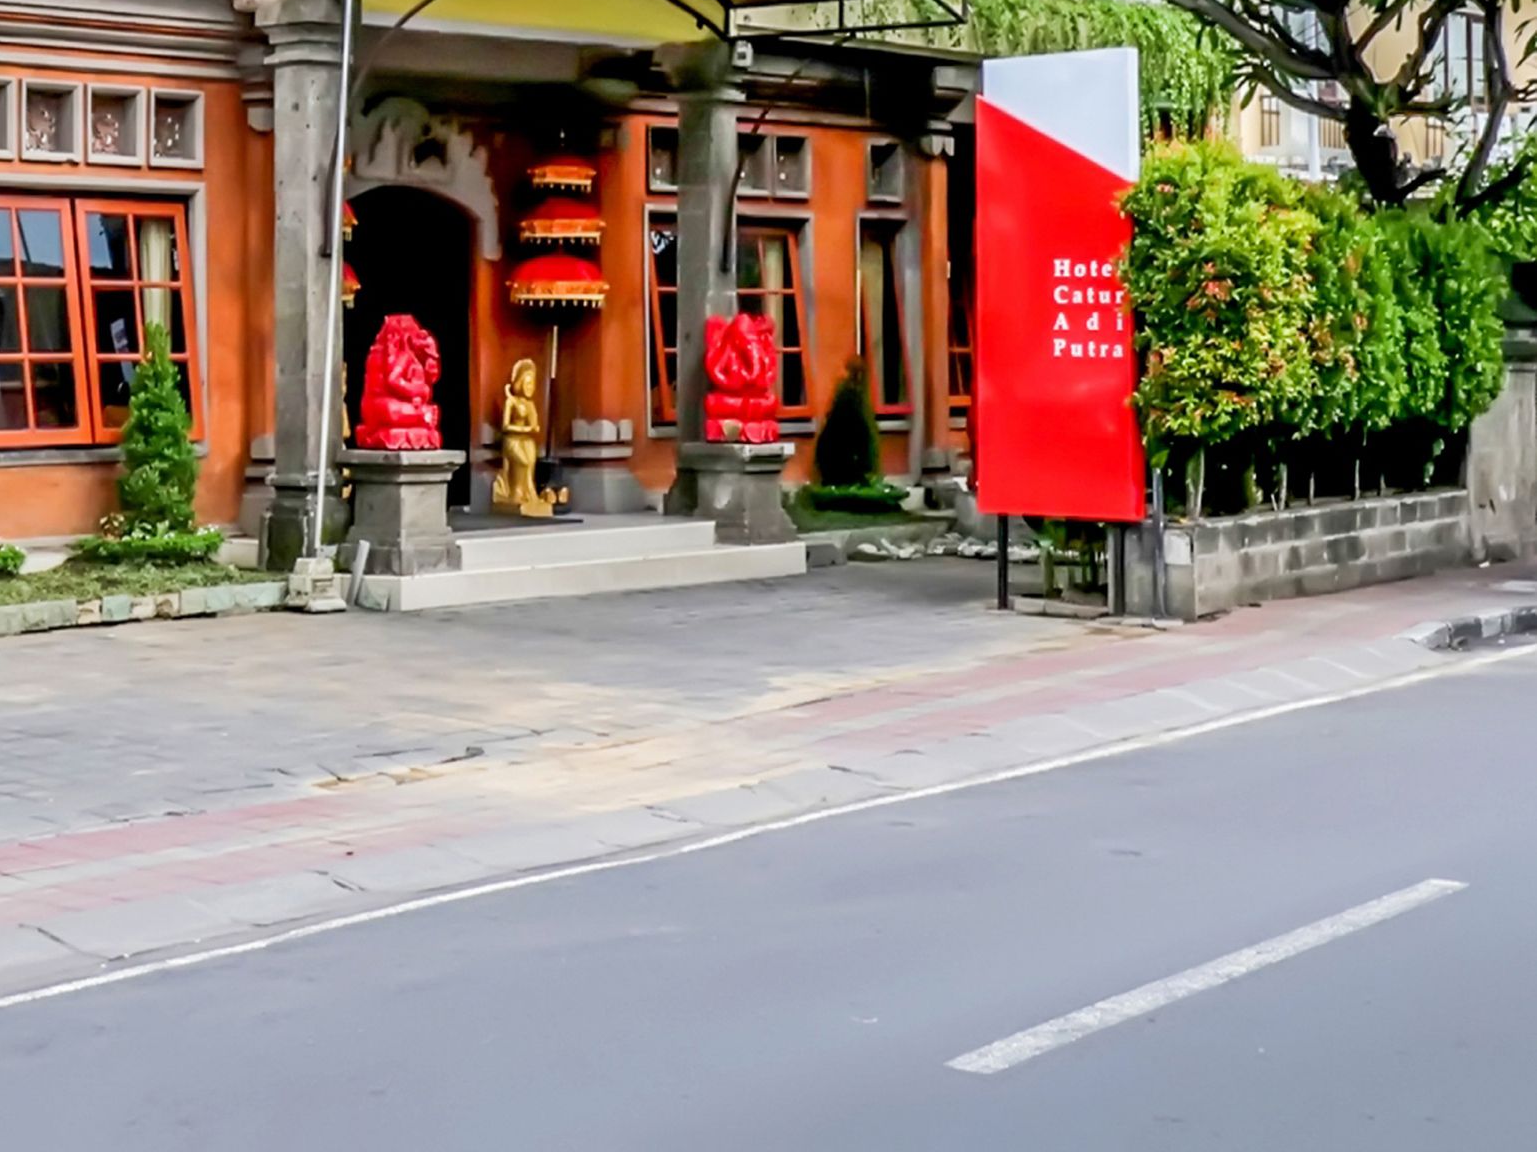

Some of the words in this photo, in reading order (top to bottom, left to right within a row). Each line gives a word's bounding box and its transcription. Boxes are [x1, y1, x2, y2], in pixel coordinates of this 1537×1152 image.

[1053, 259, 1118, 277] Hote
[1053, 285, 1124, 304] Catur
[1053, 312, 1124, 331] Adi
[1053, 338, 1124, 358] Putra
